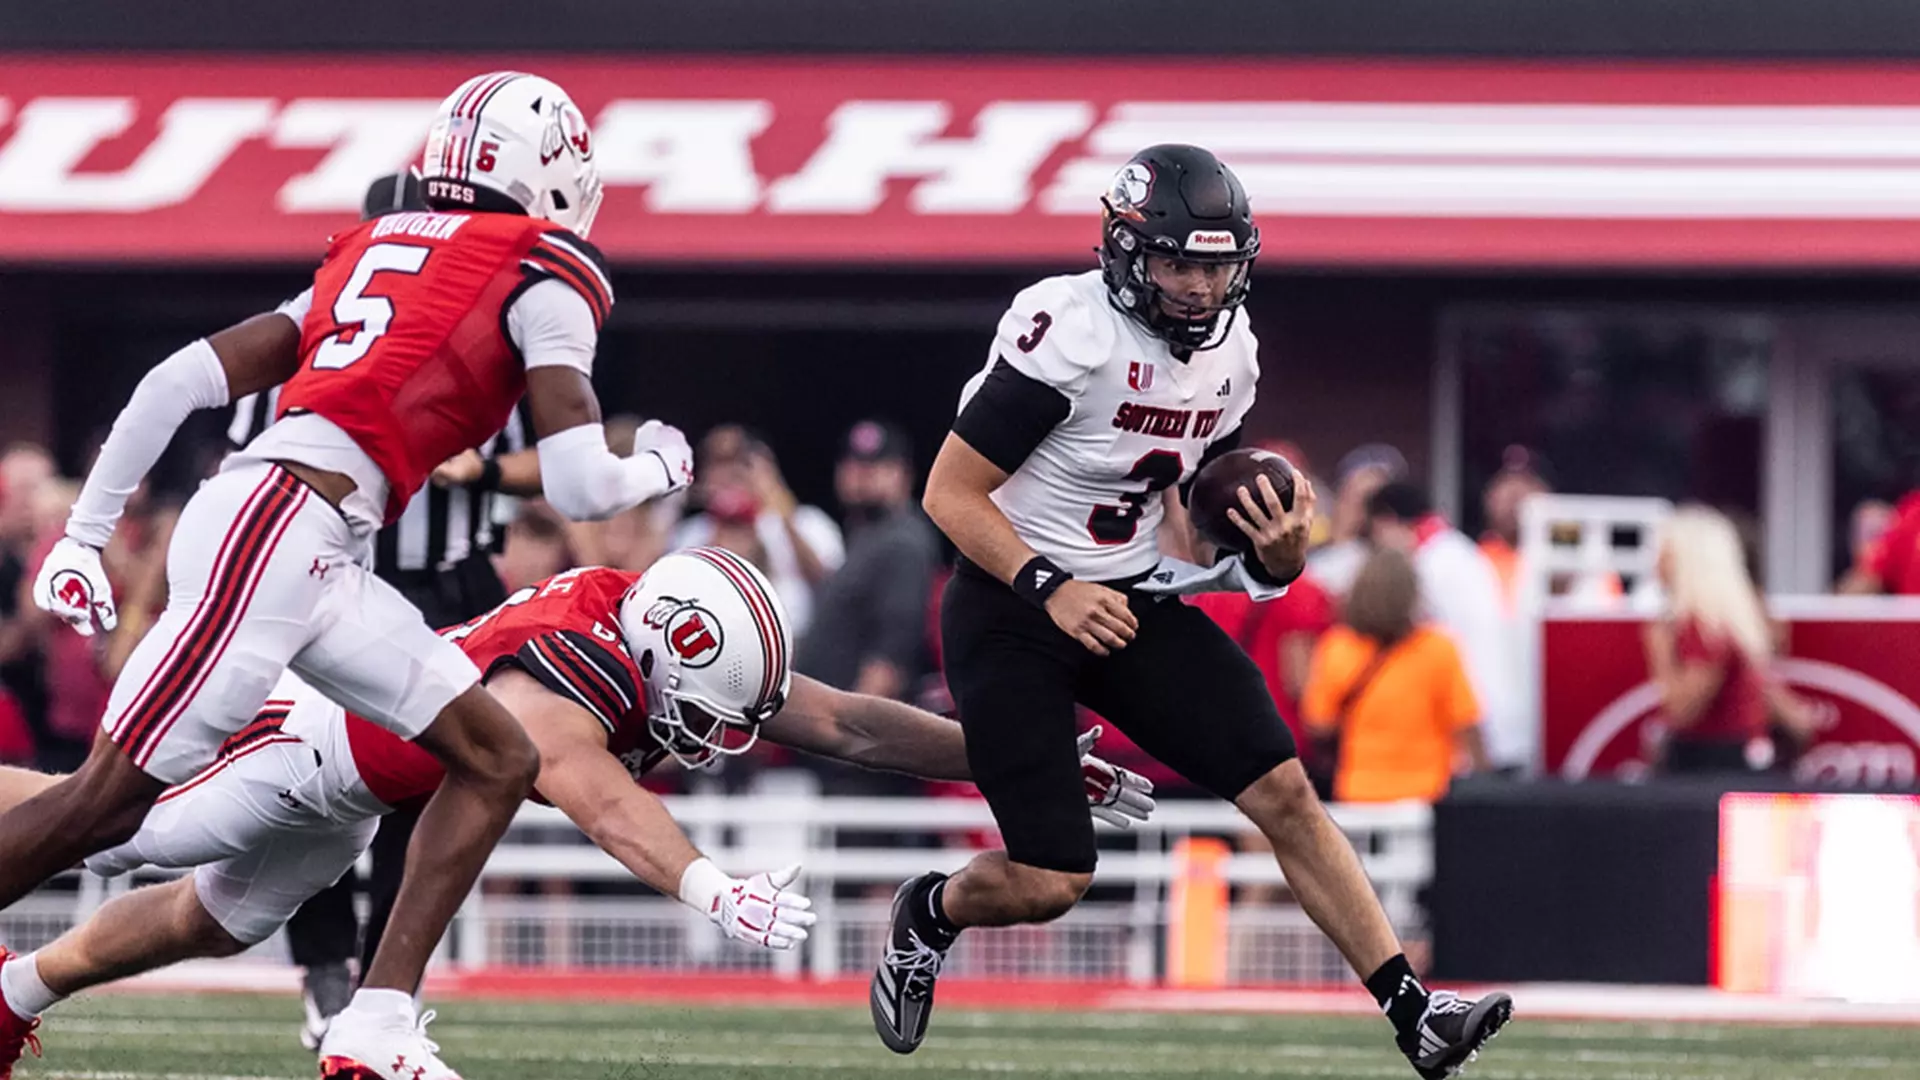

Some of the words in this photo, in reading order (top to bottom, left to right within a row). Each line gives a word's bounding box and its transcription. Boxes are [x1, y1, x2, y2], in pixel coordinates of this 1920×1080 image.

[0, 98, 1098, 213] UTAH
[476, 141, 499, 172] 5
[428, 181, 474, 203] UTES
[370, 212, 471, 239] VAUGHN
[1194, 234, 1231, 244] Riddell
[311, 241, 433, 371] 5
[1017, 311, 1053, 353] 3
[1112, 401, 1192, 439] SOUTHERN
[1191, 407, 1224, 438] UT
[1086, 449, 1184, 545] 3
[670, 611, 718, 660] U
